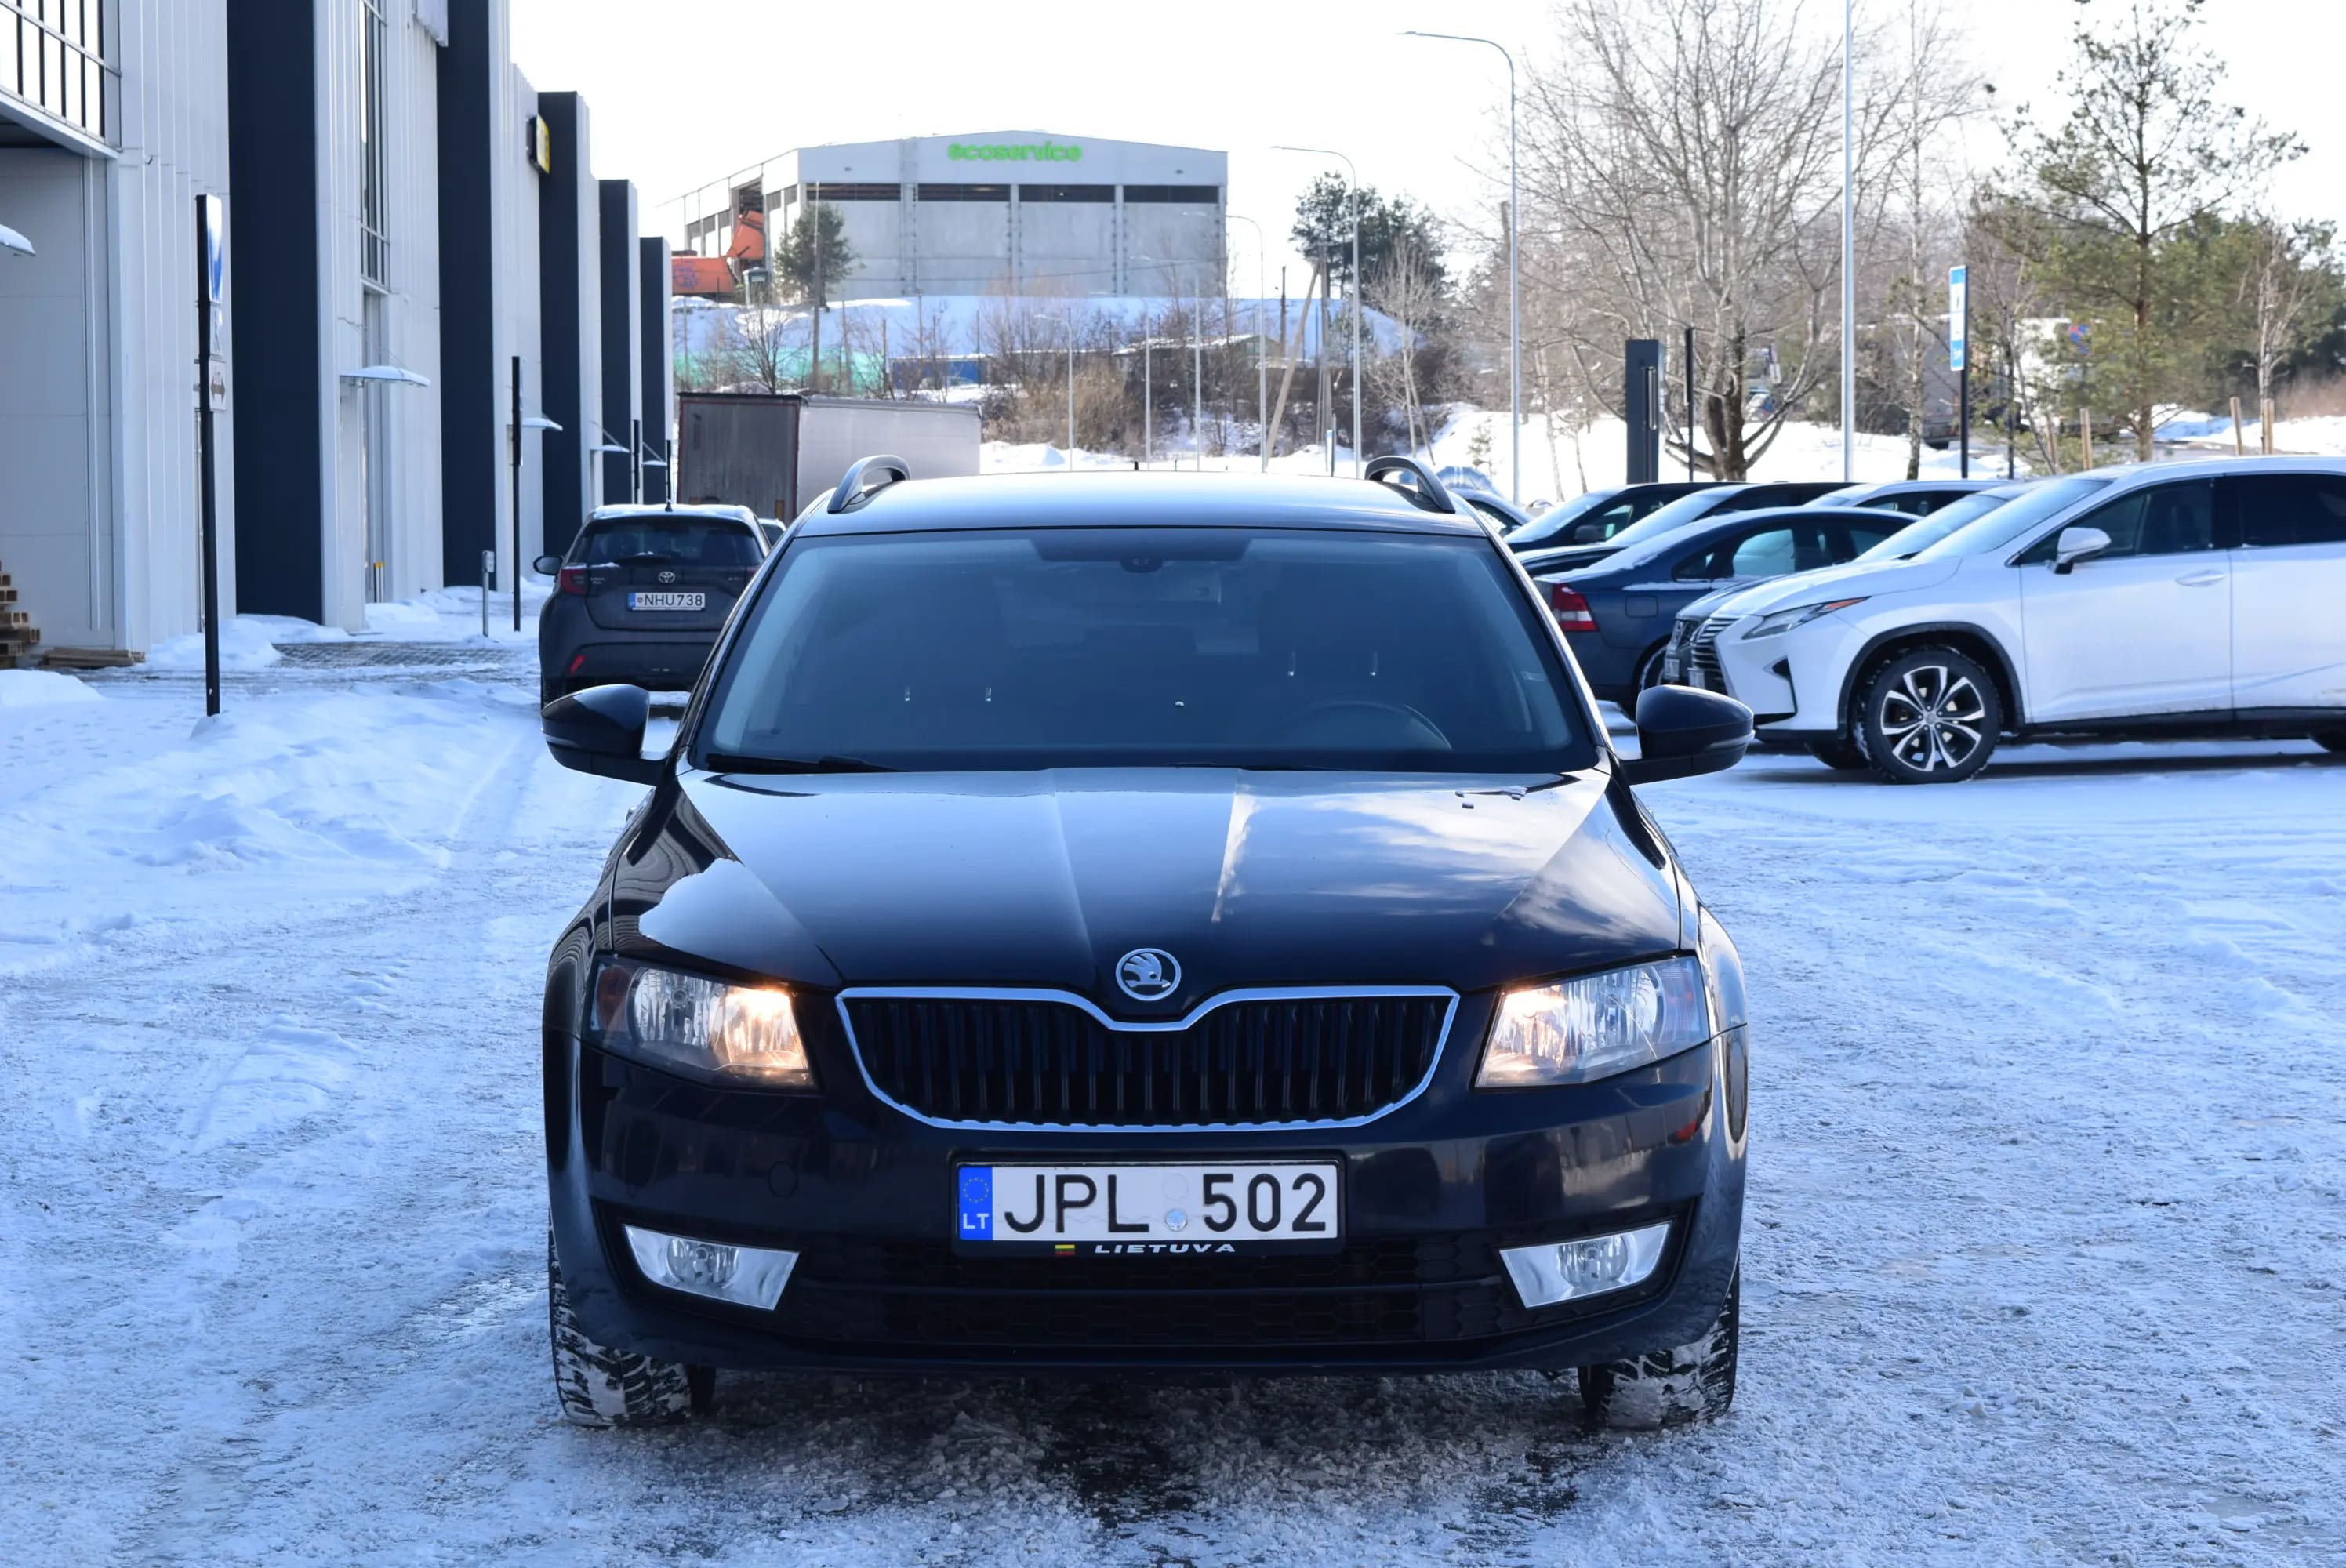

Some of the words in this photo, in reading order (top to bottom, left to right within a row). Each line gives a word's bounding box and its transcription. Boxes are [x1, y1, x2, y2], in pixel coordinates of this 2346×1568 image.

[948, 140, 1082, 162] ecoservice
[1004, 1174, 1149, 1233] JPL
[1203, 1173, 1327, 1232] 502
[963, 1213, 990, 1230] LT
[1095, 1244, 1236, 1254] LIETUVA
